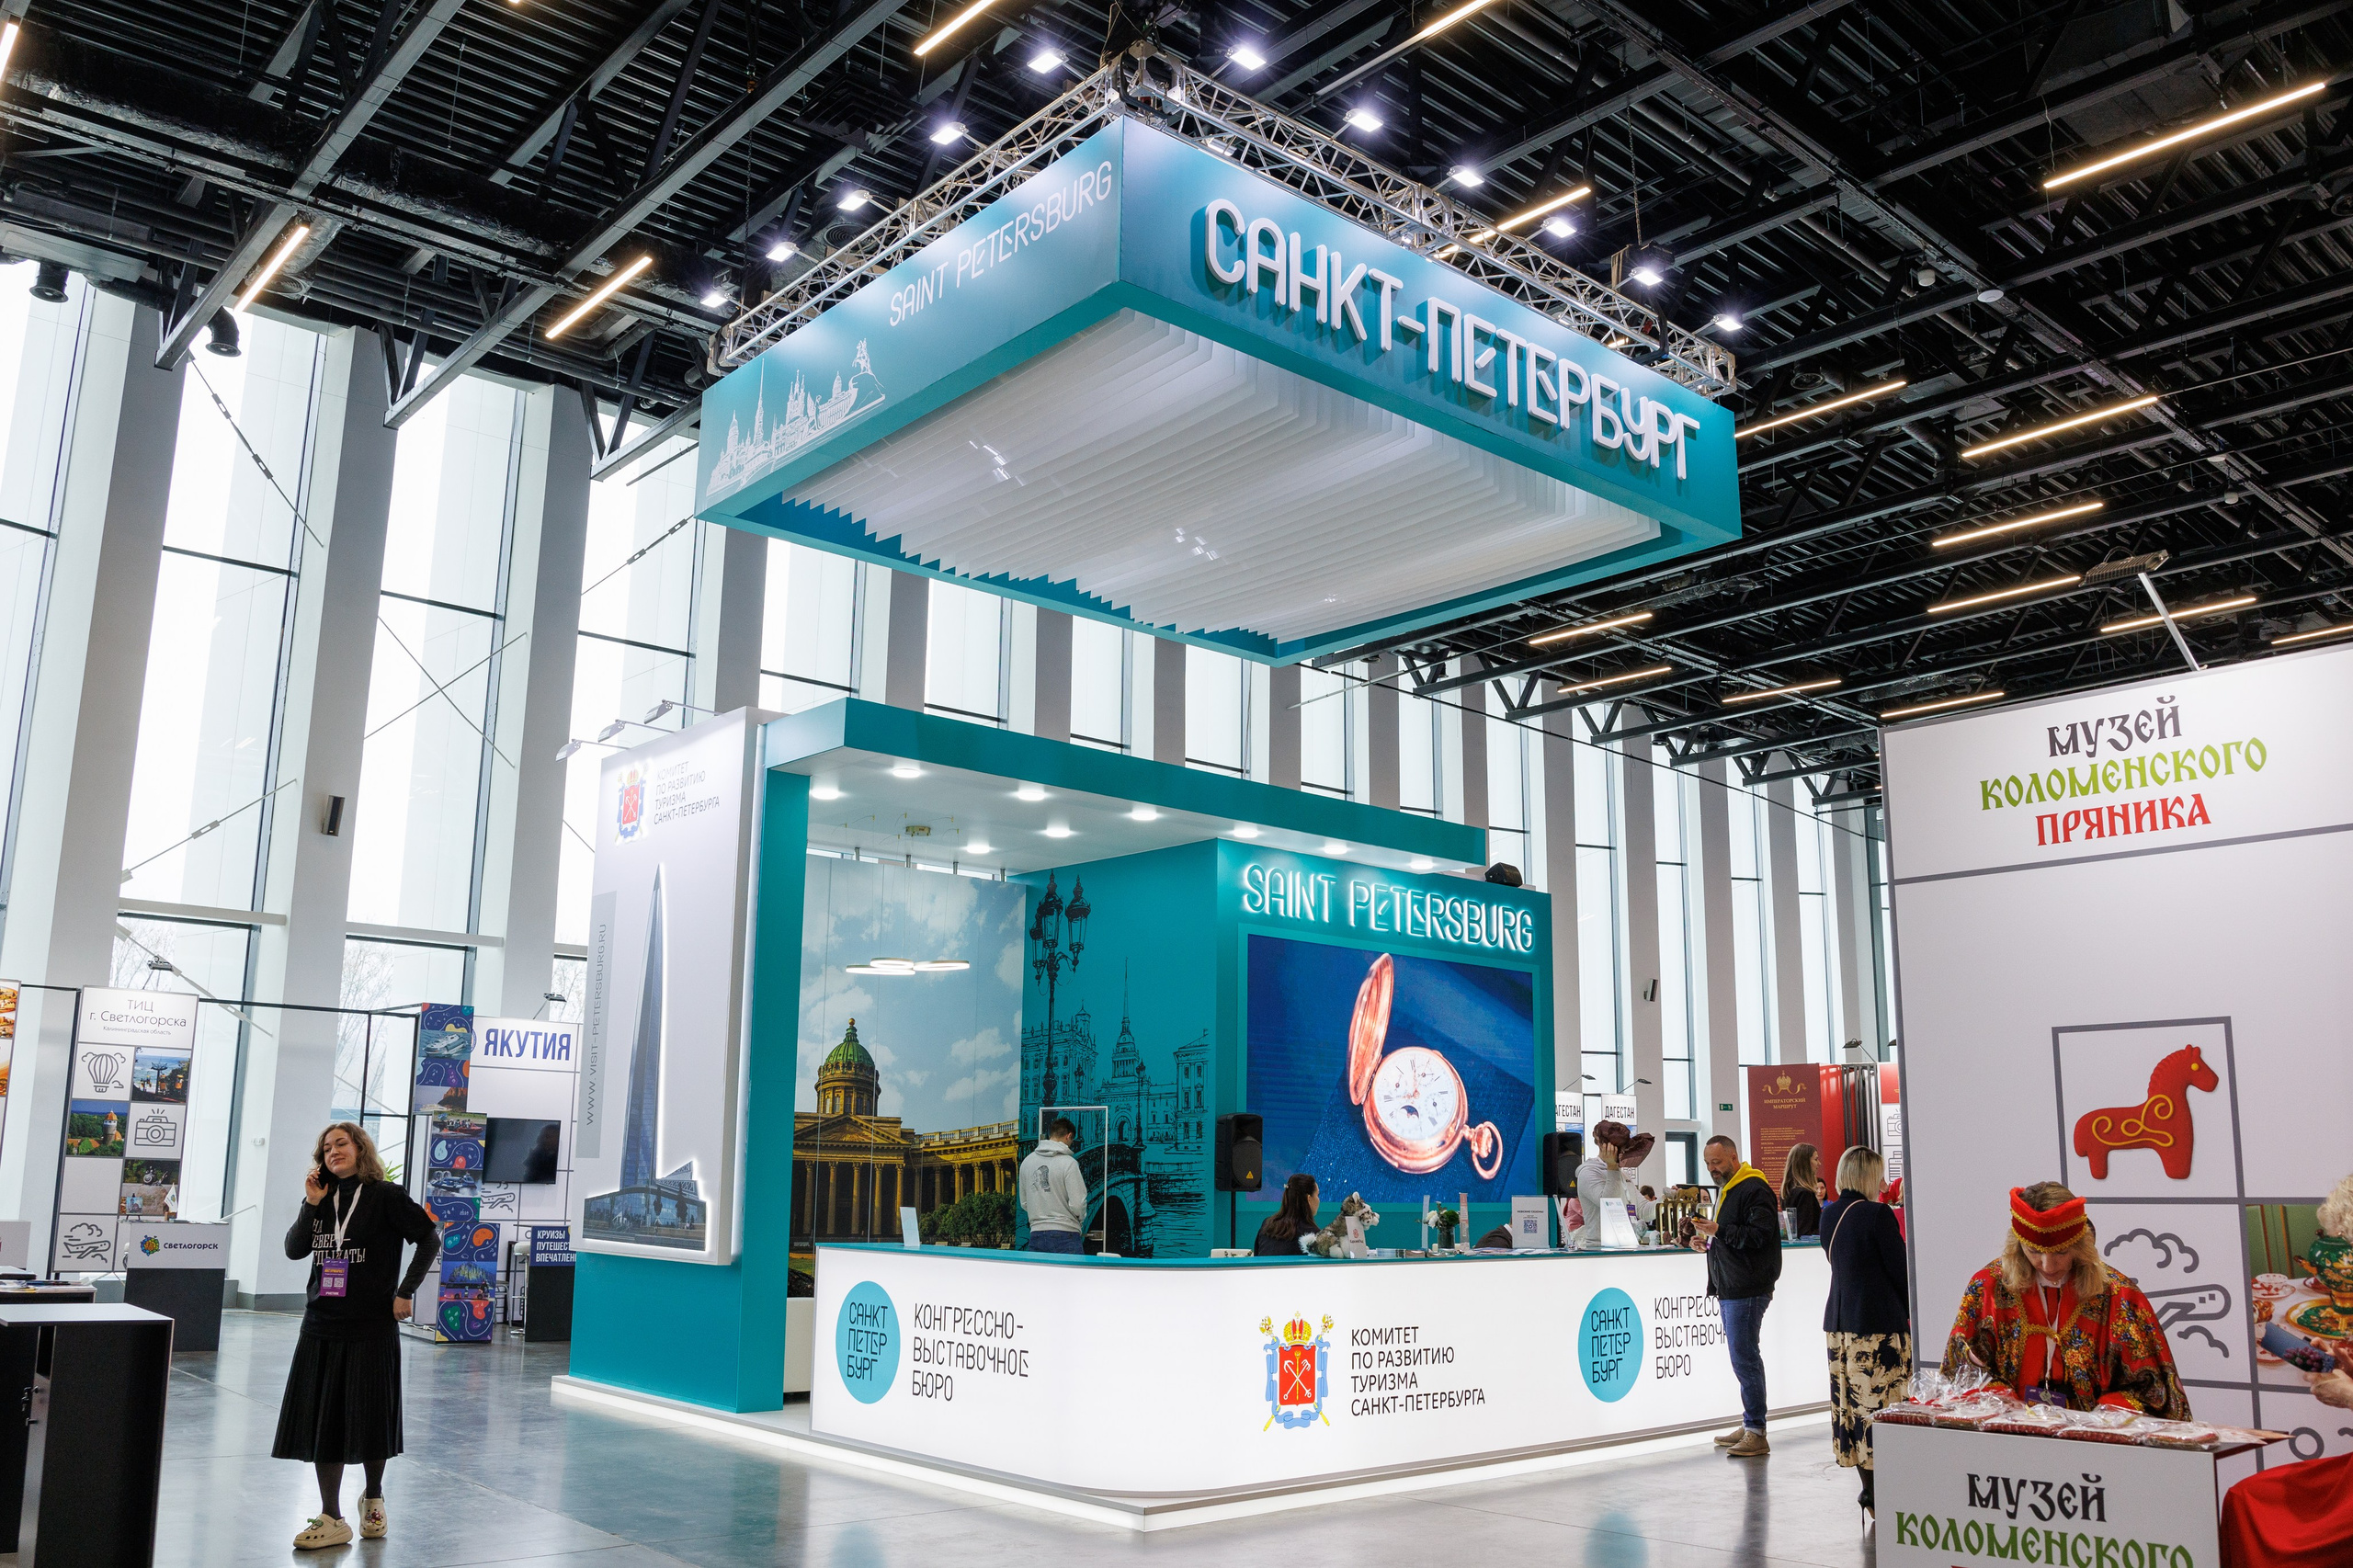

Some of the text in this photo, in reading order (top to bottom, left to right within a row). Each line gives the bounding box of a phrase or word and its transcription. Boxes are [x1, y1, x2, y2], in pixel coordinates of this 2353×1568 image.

[890, 161, 1112, 326] SAINT PETERSBURG
[1205, 199, 1700, 481] САНКТ-ПЕТЕРБУРГ
[2048, 695, 2182, 757] МУЗЕЙ
[655, 770, 706, 796] ПО РАЗВИТИЮ
[657, 761, 689, 780] КОМИТЕТ
[1980, 736, 2267, 811] КОЛОМЕНСКОГО
[654, 796, 720, 824] САНКТ-ПЕТЕРБУРГА
[655, 791, 687, 811] ТУРИЗМА
[2035, 793, 2211, 846] ПРЯНИКА
[1245, 864, 1534, 951] SAINT PETERSBURG
[89, 1010, 187, 1028] г. Светлогорска
[128, 999, 154, 1013] ТИЦ
[103, 1025, 172, 1036] Калининградская область
[585, 924, 607, 1126] WWW.VISIT-PETERSBURG.RU
[483, 1028, 571, 1061] ЯКУТИЯ
[1604, 1106, 1635, 1119] ДАГЕСТАН
[313, 1233, 338, 1248] ЕВЕР
[537, 1230, 566, 1240] КРУИЗЫ
[849, 1301, 888, 1329] САНКТ
[914, 1302, 1024, 1340] КОНГРЕССНО-
[1591, 1306, 1631, 1333] САНКТ
[847, 1328, 888, 1356] ПЕТЕР
[1351, 1326, 1419, 1346] КОМИТЕТ
[1591, 1332, 1631, 1358] ПЕТЕР
[847, 1355, 878, 1381] БУРГ
[913, 1336, 1029, 1378] ВЫСТАВОЧНОЕ
[1351, 1346, 1455, 1369] ПО РАЗВИТИЮ
[1655, 1354, 1691, 1380] БЮРО
[1351, 1371, 1418, 1393] ТУРИЗМА
[1592, 1358, 1624, 1384] БУРГ
[912, 1369, 953, 1402] БЮРО
[1350, 1388, 1485, 1416] САНКТ-ПЕТЕРБУРГА
[1966, 1472, 2107, 1523] МУЗЕЙ
